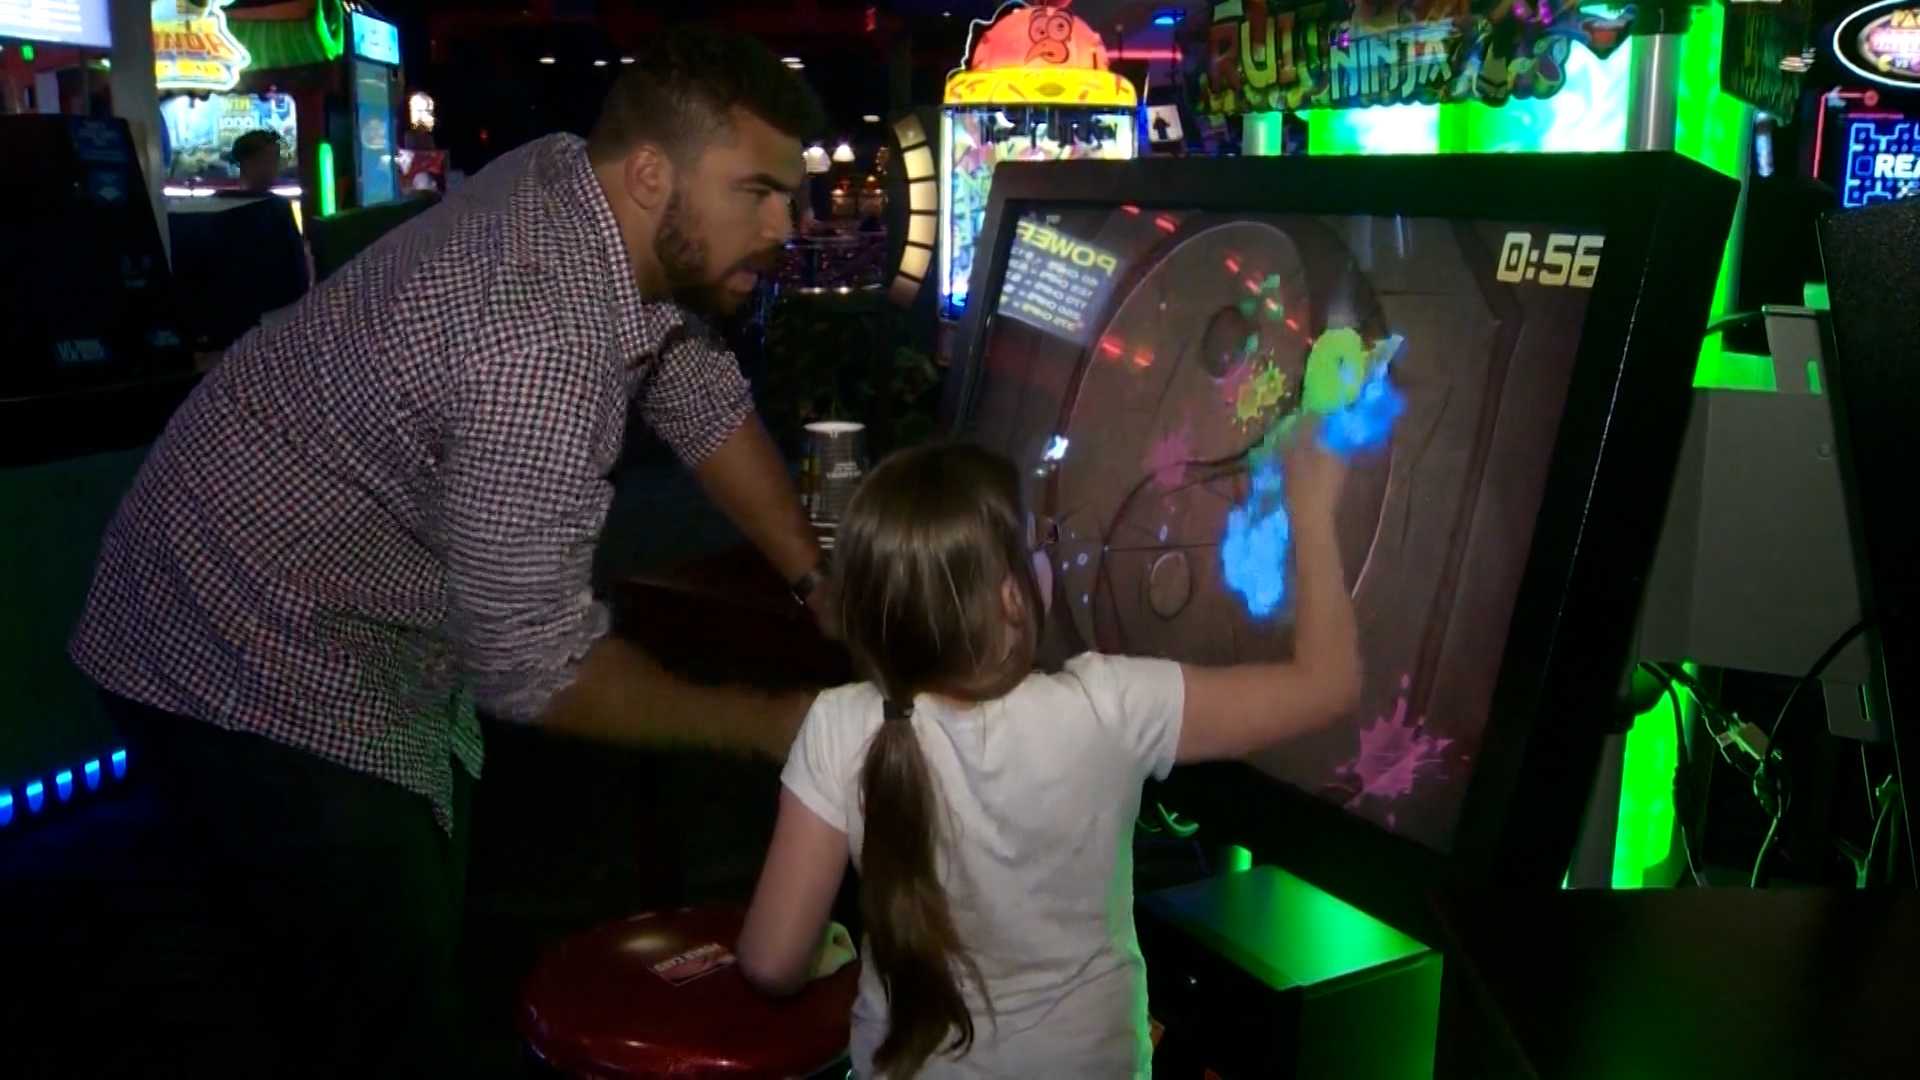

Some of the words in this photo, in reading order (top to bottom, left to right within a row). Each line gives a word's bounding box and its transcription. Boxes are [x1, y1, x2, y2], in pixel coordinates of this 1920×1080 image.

[1890, 9, 1920, 27] PA
[1329, 34, 1452, 99] NINJA
[1496, 231, 1606, 288] 0:56
